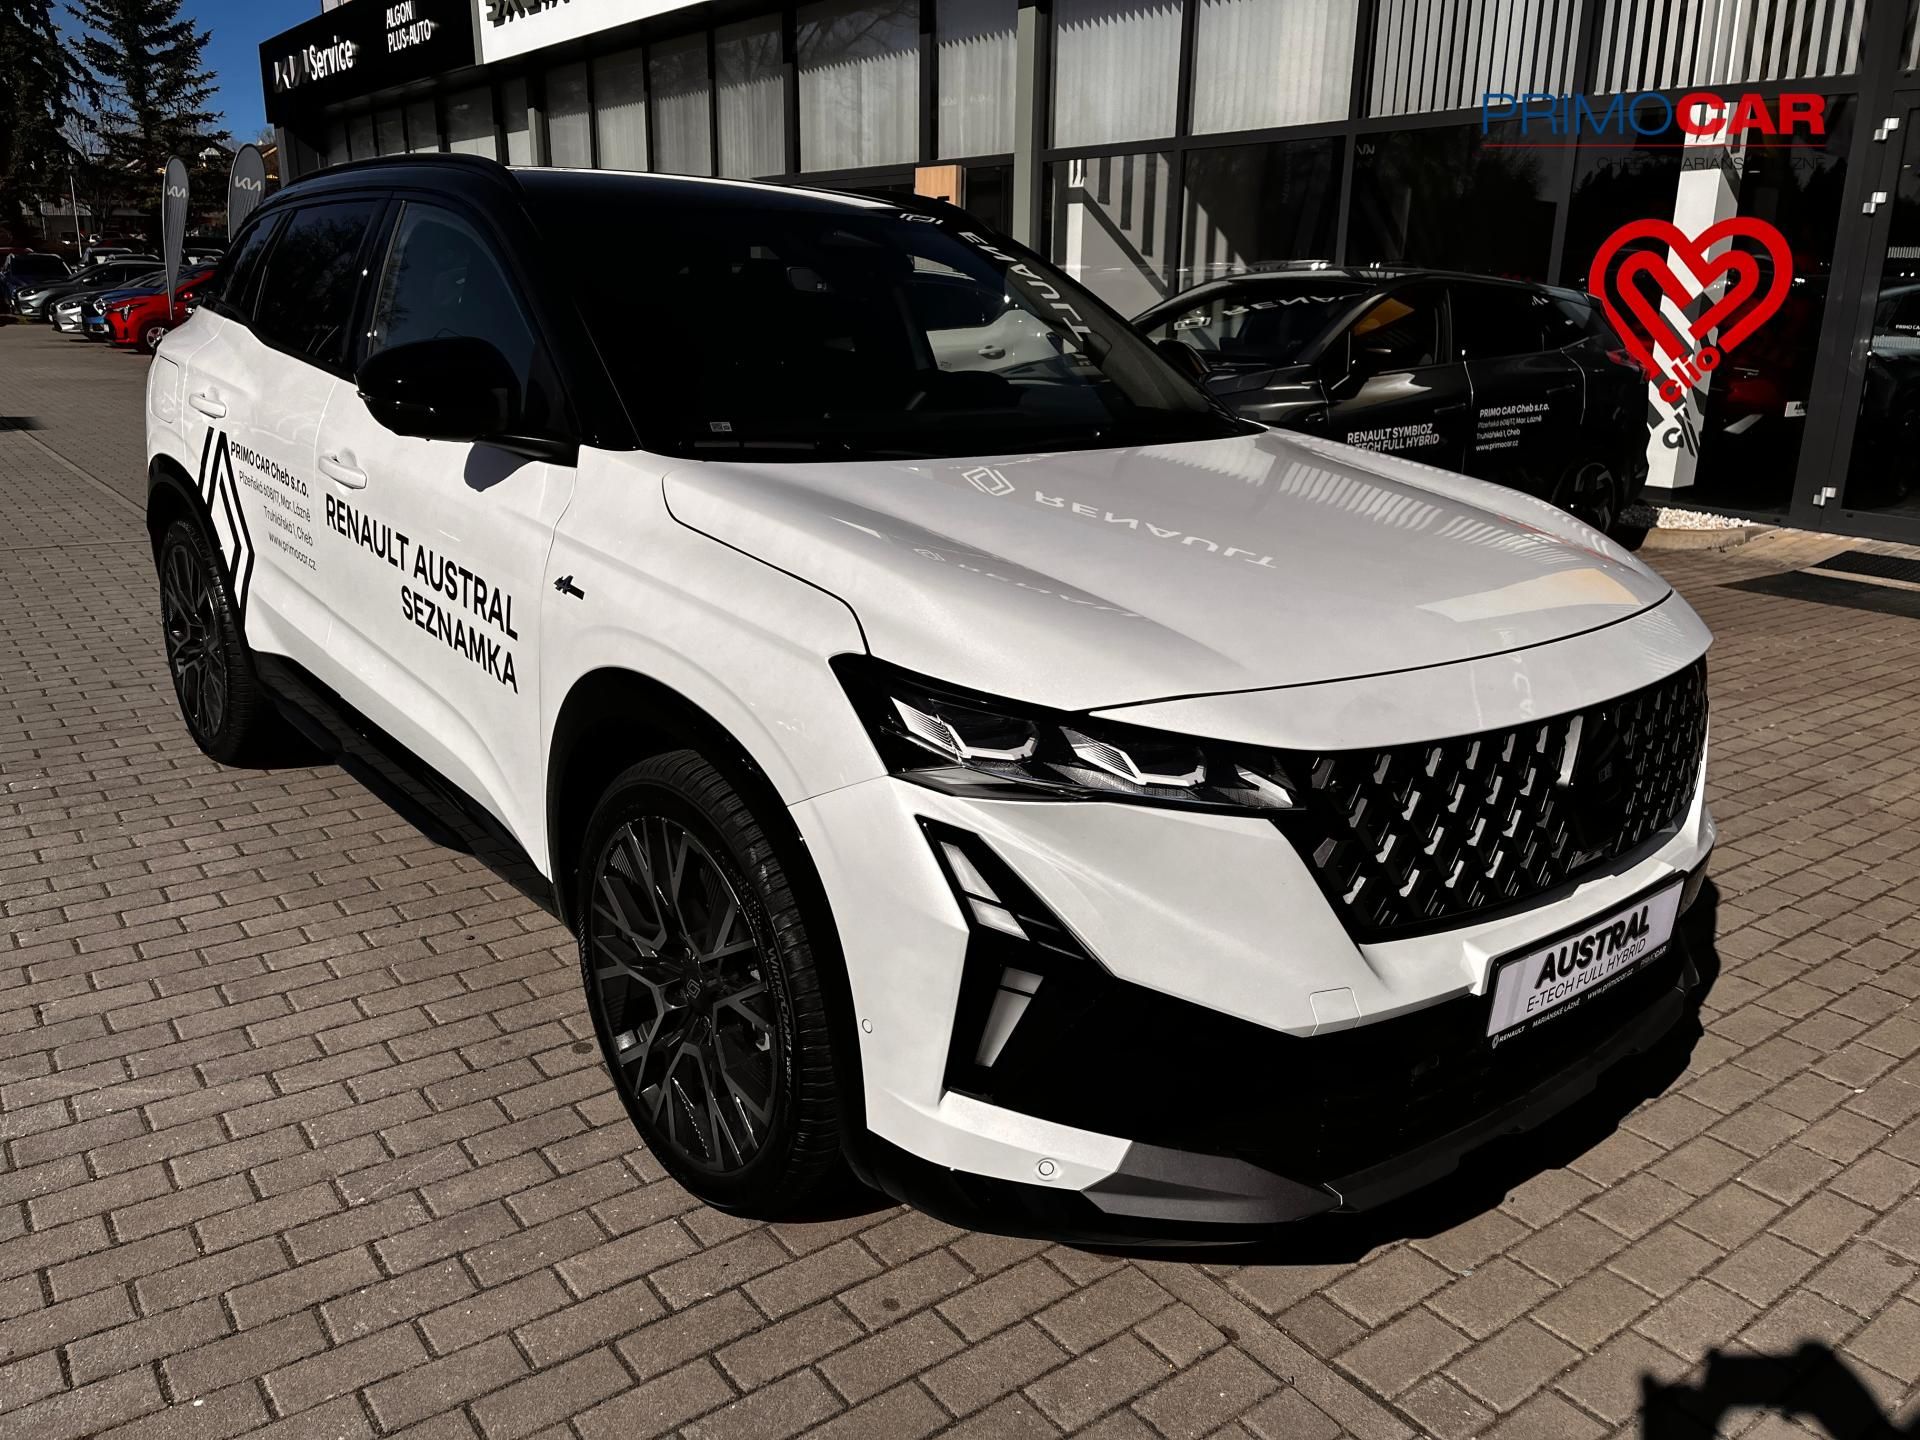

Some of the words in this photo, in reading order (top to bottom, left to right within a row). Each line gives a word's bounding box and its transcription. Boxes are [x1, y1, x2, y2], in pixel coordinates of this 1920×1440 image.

[385, 1, 413, 30] ALGON
[387, 18, 432, 53] PLUS-AUTO
[309, 36, 354, 81] Service
[235, 175, 261, 192] KIA
[1658, 346, 1721, 403] clio
[1479, 406, 1502, 418] PRIMO
[1502, 405, 1516, 415] CAR
[1516, 403, 1534, 414] Cheb
[1534, 402, 1550, 412] s.r.o.
[1346, 427, 1392, 444] RENAULT
[1392, 422, 1433, 439] SYMBIOZ
[1382, 437, 1405, 451] FULL
[1405, 433, 1440, 448] HYBRID
[1507, 428, 1521, 437] Cheb
[230, 440, 255, 466] PRIMO
[255, 453, 271, 476] CAR
[270, 462, 290, 487] Cheb
[290, 475, 310, 499] s.r.o.
[267, 531, 317, 571] www.primocar.cz
[296, 526, 314, 547] Cheb
[325, 493, 410, 573] RENAULT
[413, 544, 519, 641] AUSTRAL
[400, 585, 519, 695] SEZNAMKA
[1533, 905, 1650, 990] AUSTRAL
[1526, 977, 1574, 1013] E-TECH
[1575, 967, 1605, 990] FULL
[1605, 938, 1647, 971] HYBRID
[1498, 1025, 1526, 1042] RENAULT
